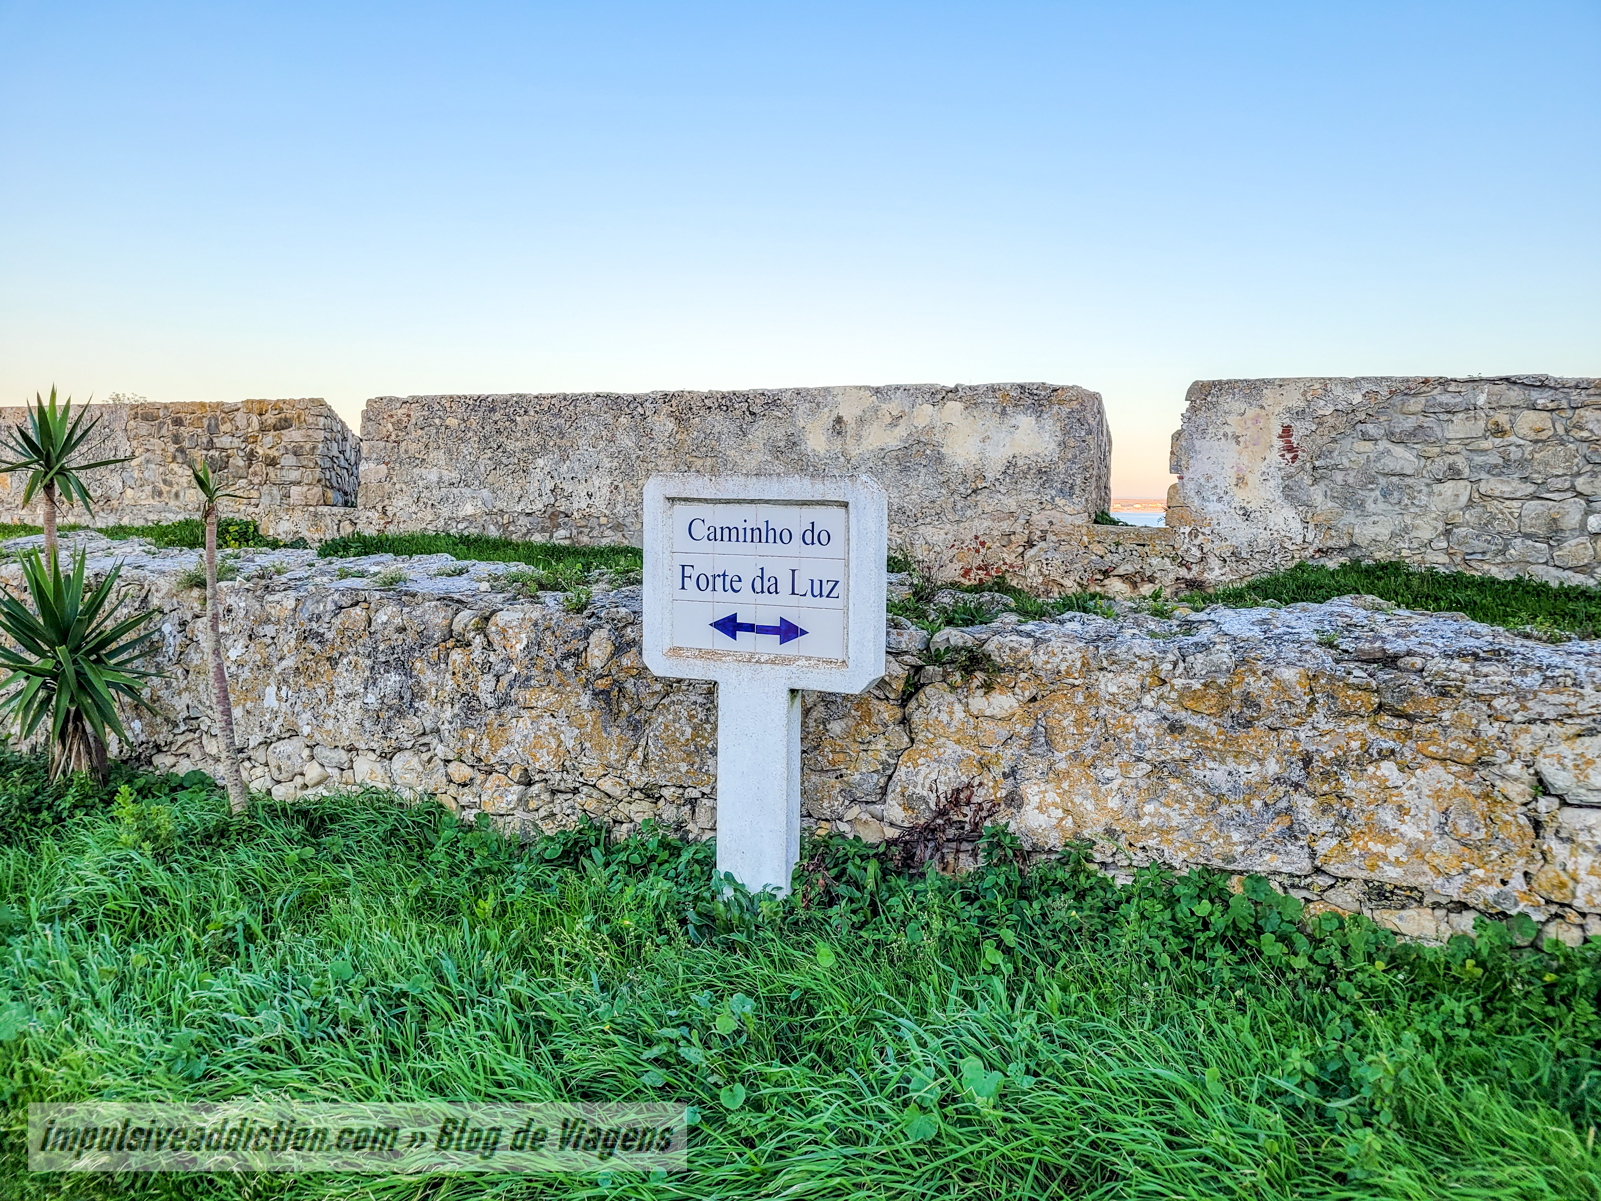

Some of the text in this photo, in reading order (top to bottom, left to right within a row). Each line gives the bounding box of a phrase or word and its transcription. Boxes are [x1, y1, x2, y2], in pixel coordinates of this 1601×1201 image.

[687, 517, 831, 546] Caminho do
[678, 564, 840, 599] Forte da Luz
